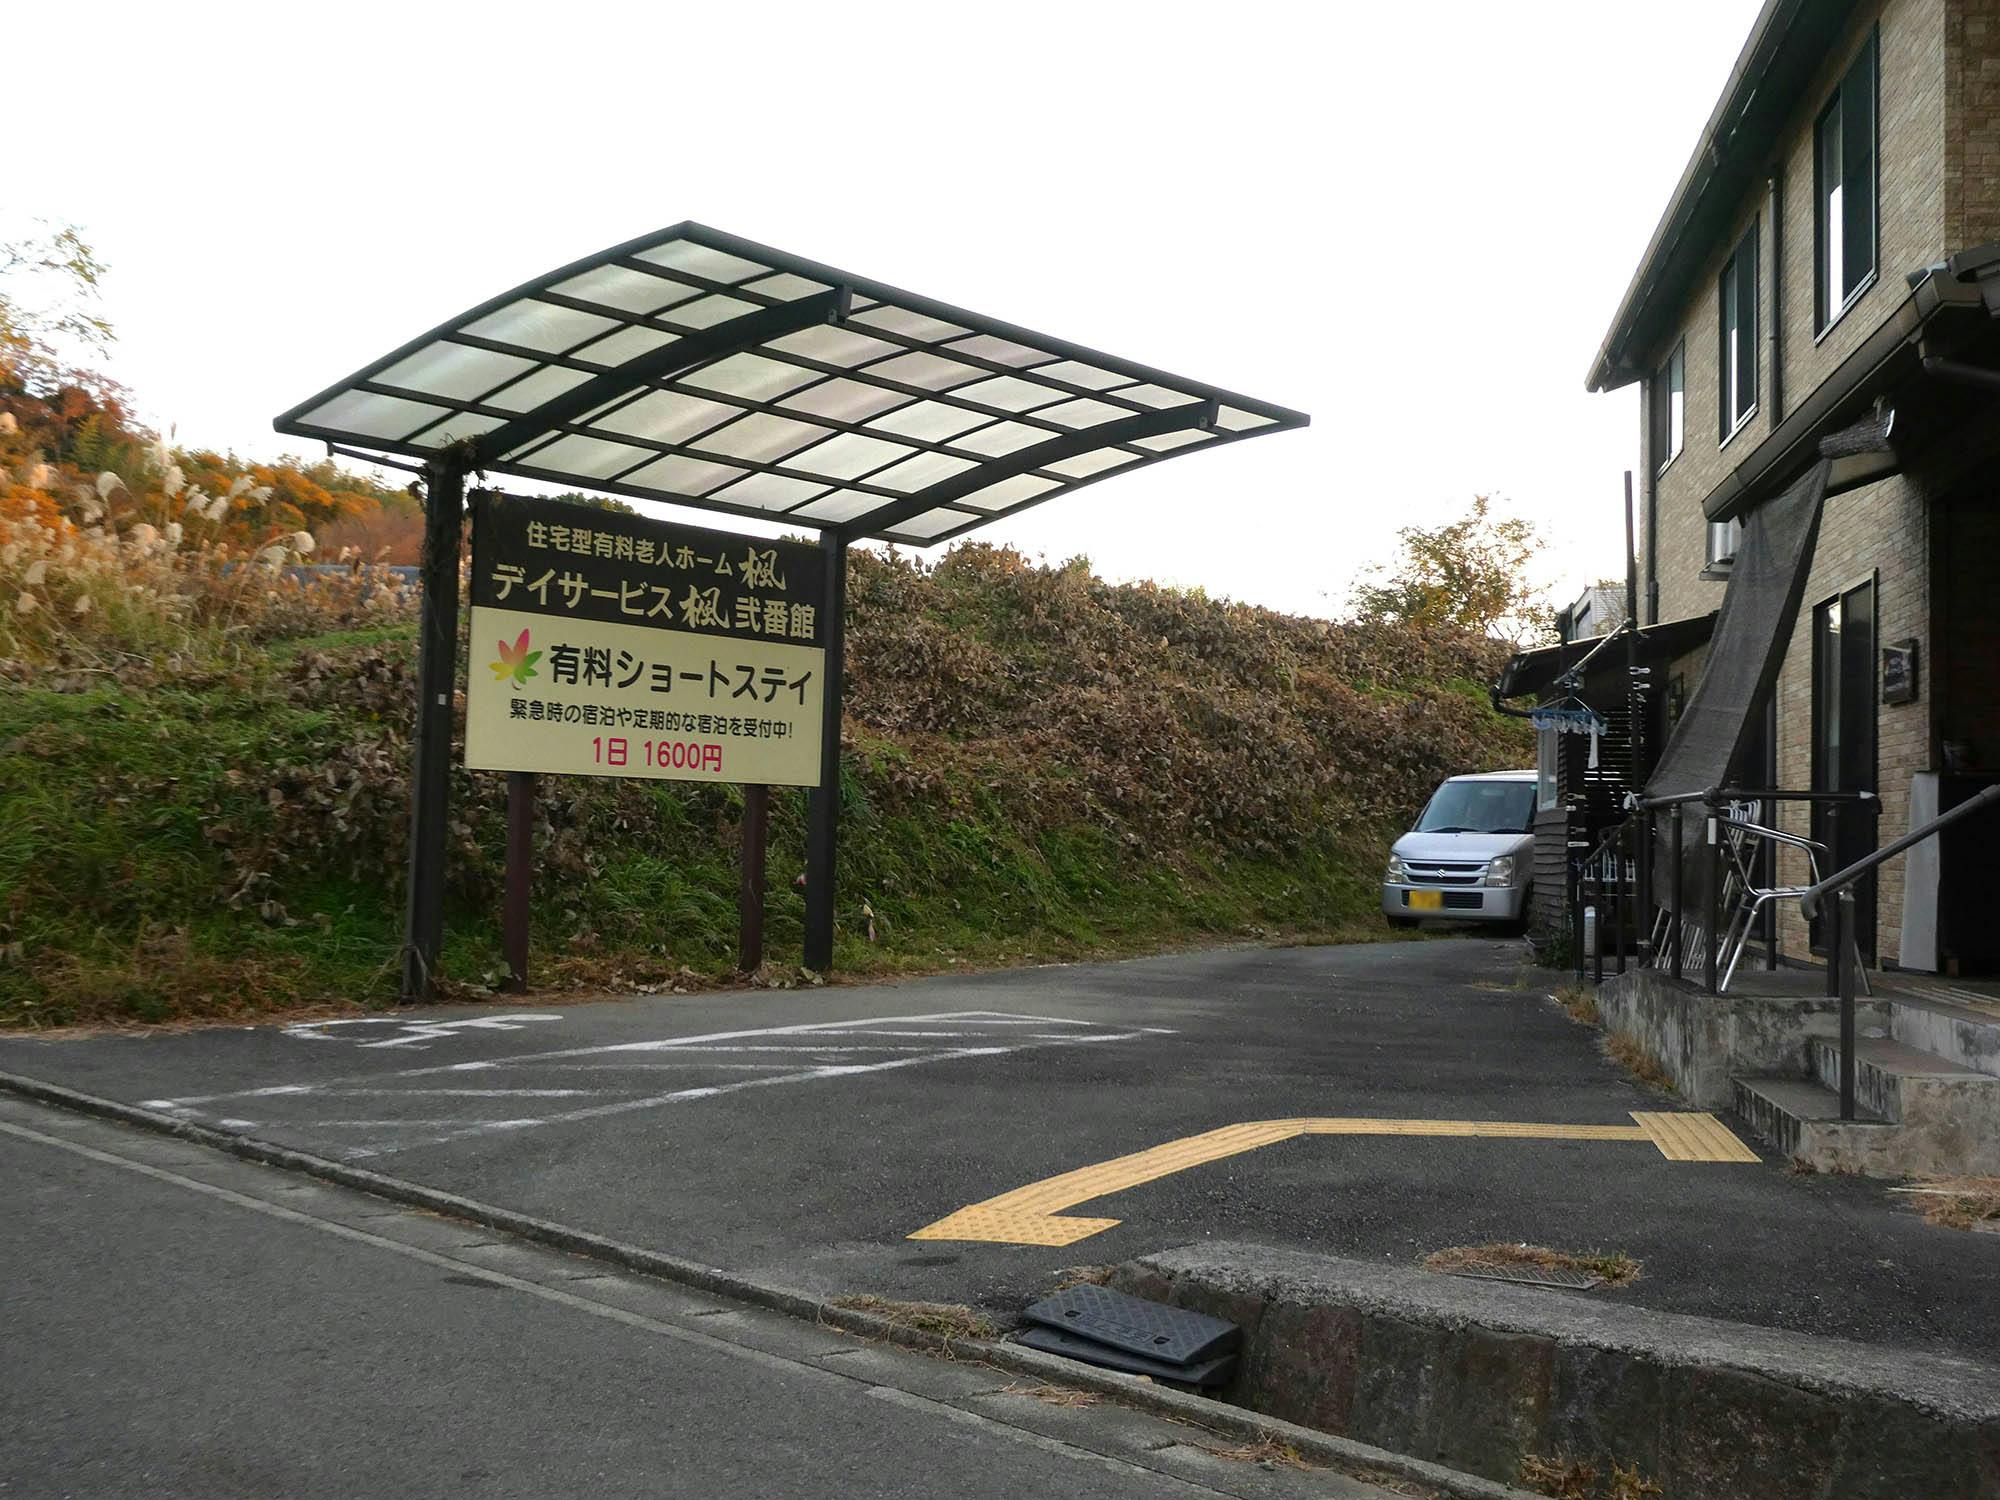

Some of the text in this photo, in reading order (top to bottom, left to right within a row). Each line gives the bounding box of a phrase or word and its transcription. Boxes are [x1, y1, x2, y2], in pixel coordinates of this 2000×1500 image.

[549, 643, 812, 705] 有料ショートステイ
[644, 740, 722, 773] 1600円
